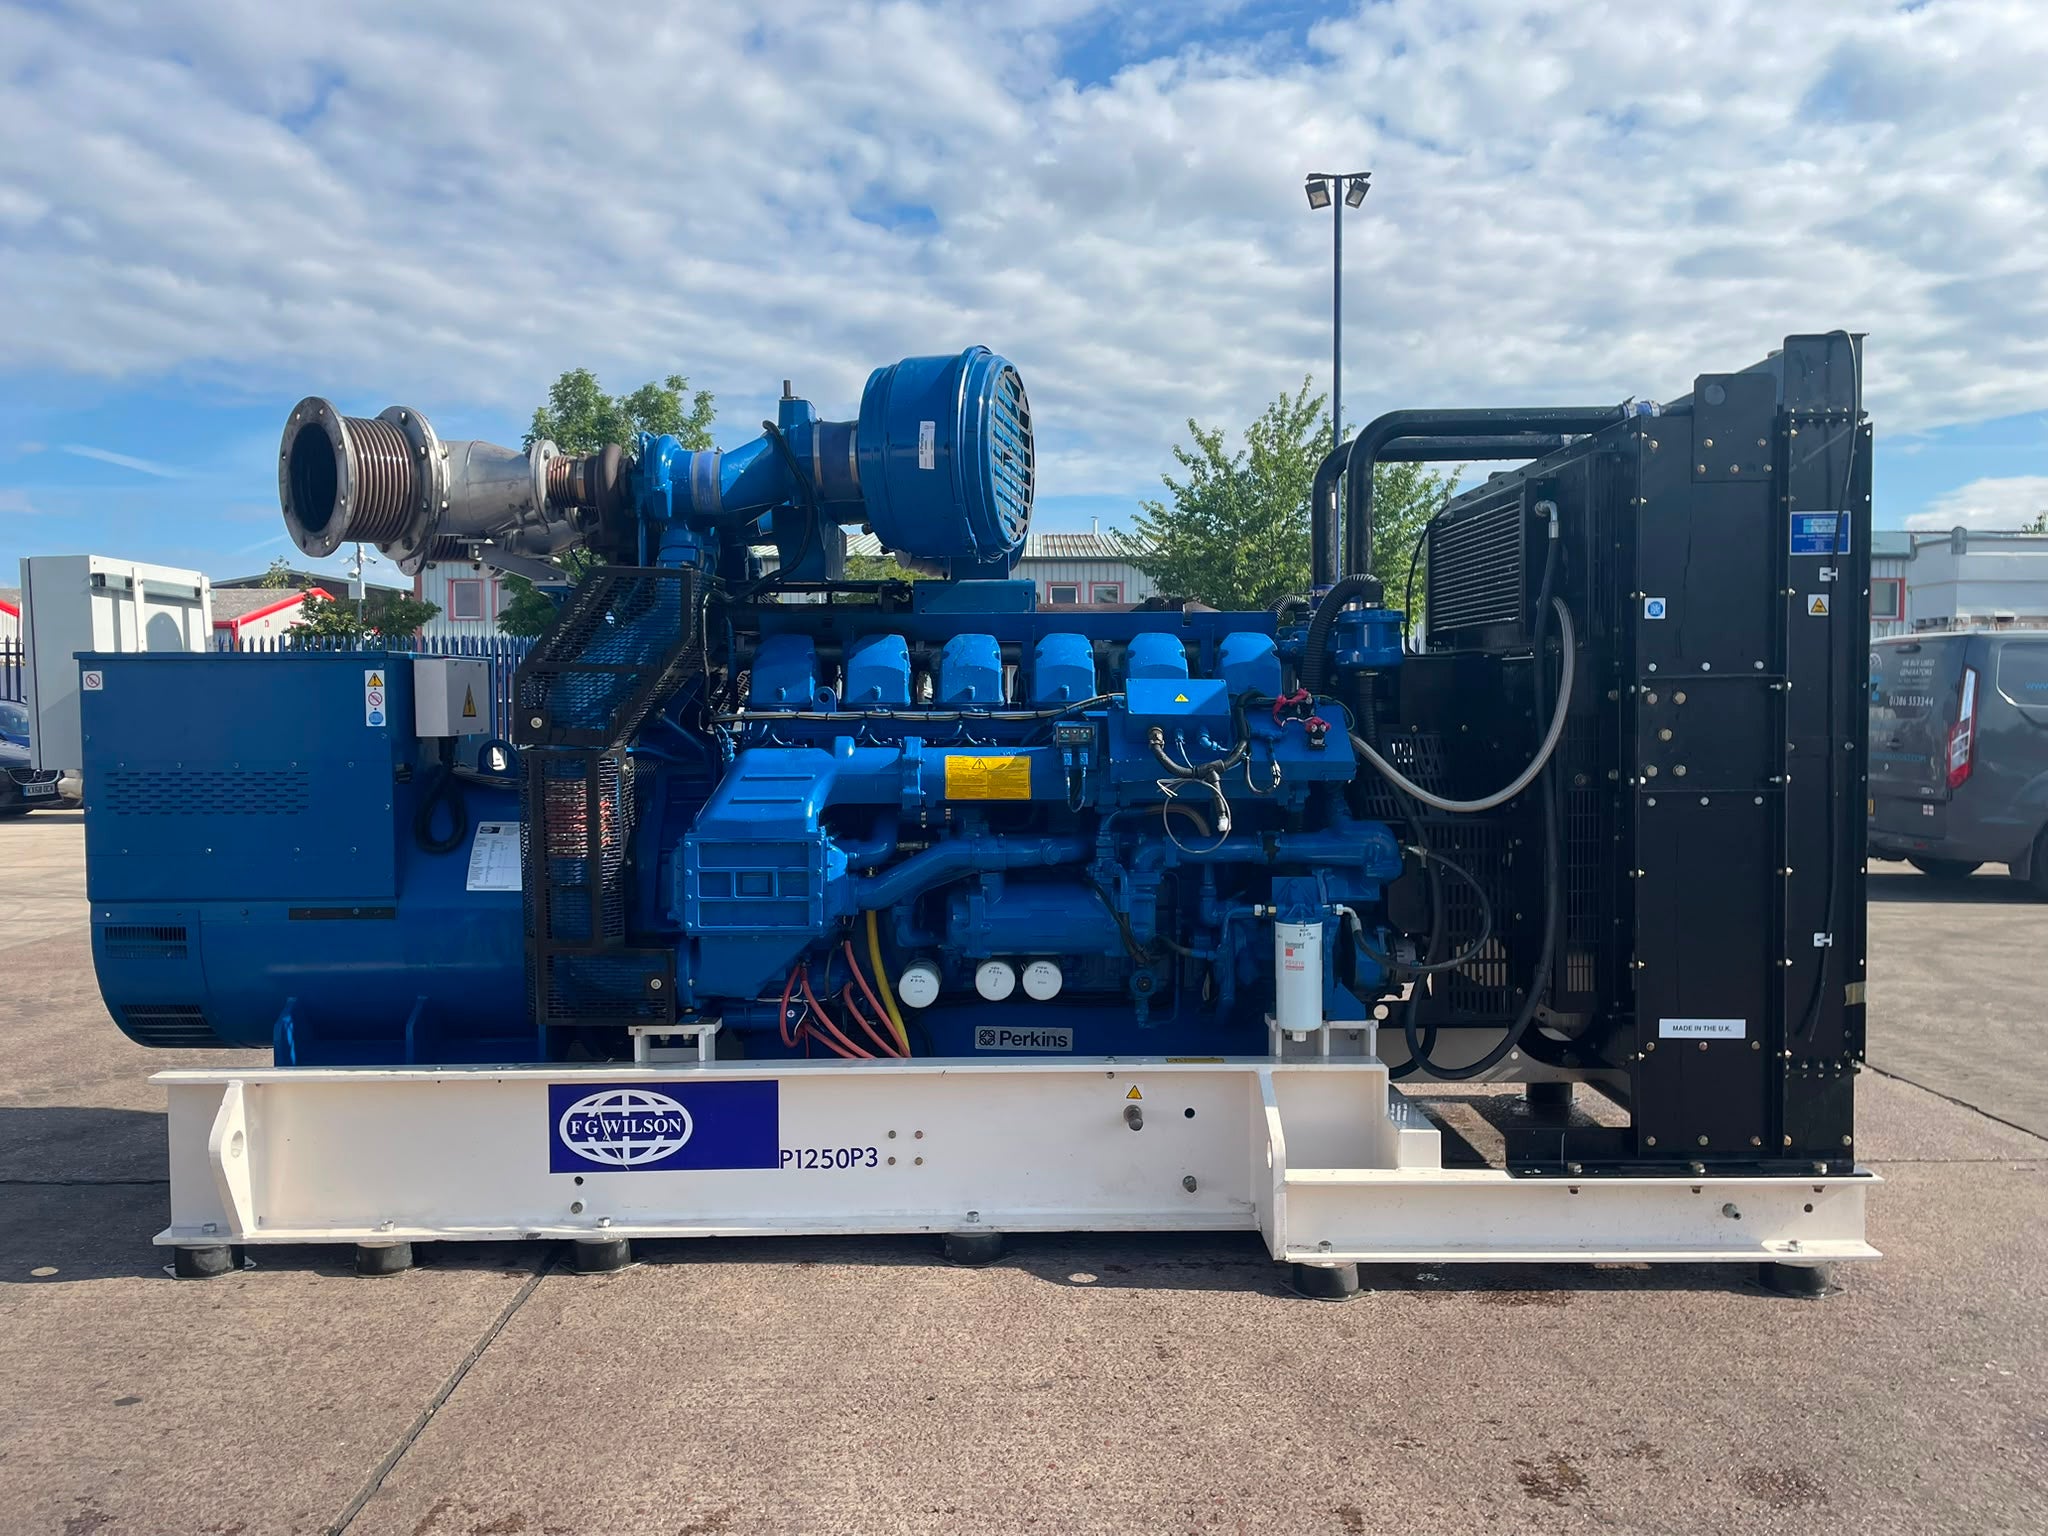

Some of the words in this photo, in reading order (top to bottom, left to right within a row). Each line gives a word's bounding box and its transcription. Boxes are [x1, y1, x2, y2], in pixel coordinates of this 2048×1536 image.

[1000, 1030, 1068, 1047] Perkins
[603, 1118, 682, 1134] WILSON
[780, 1147, 878, 1169] P1250P3
